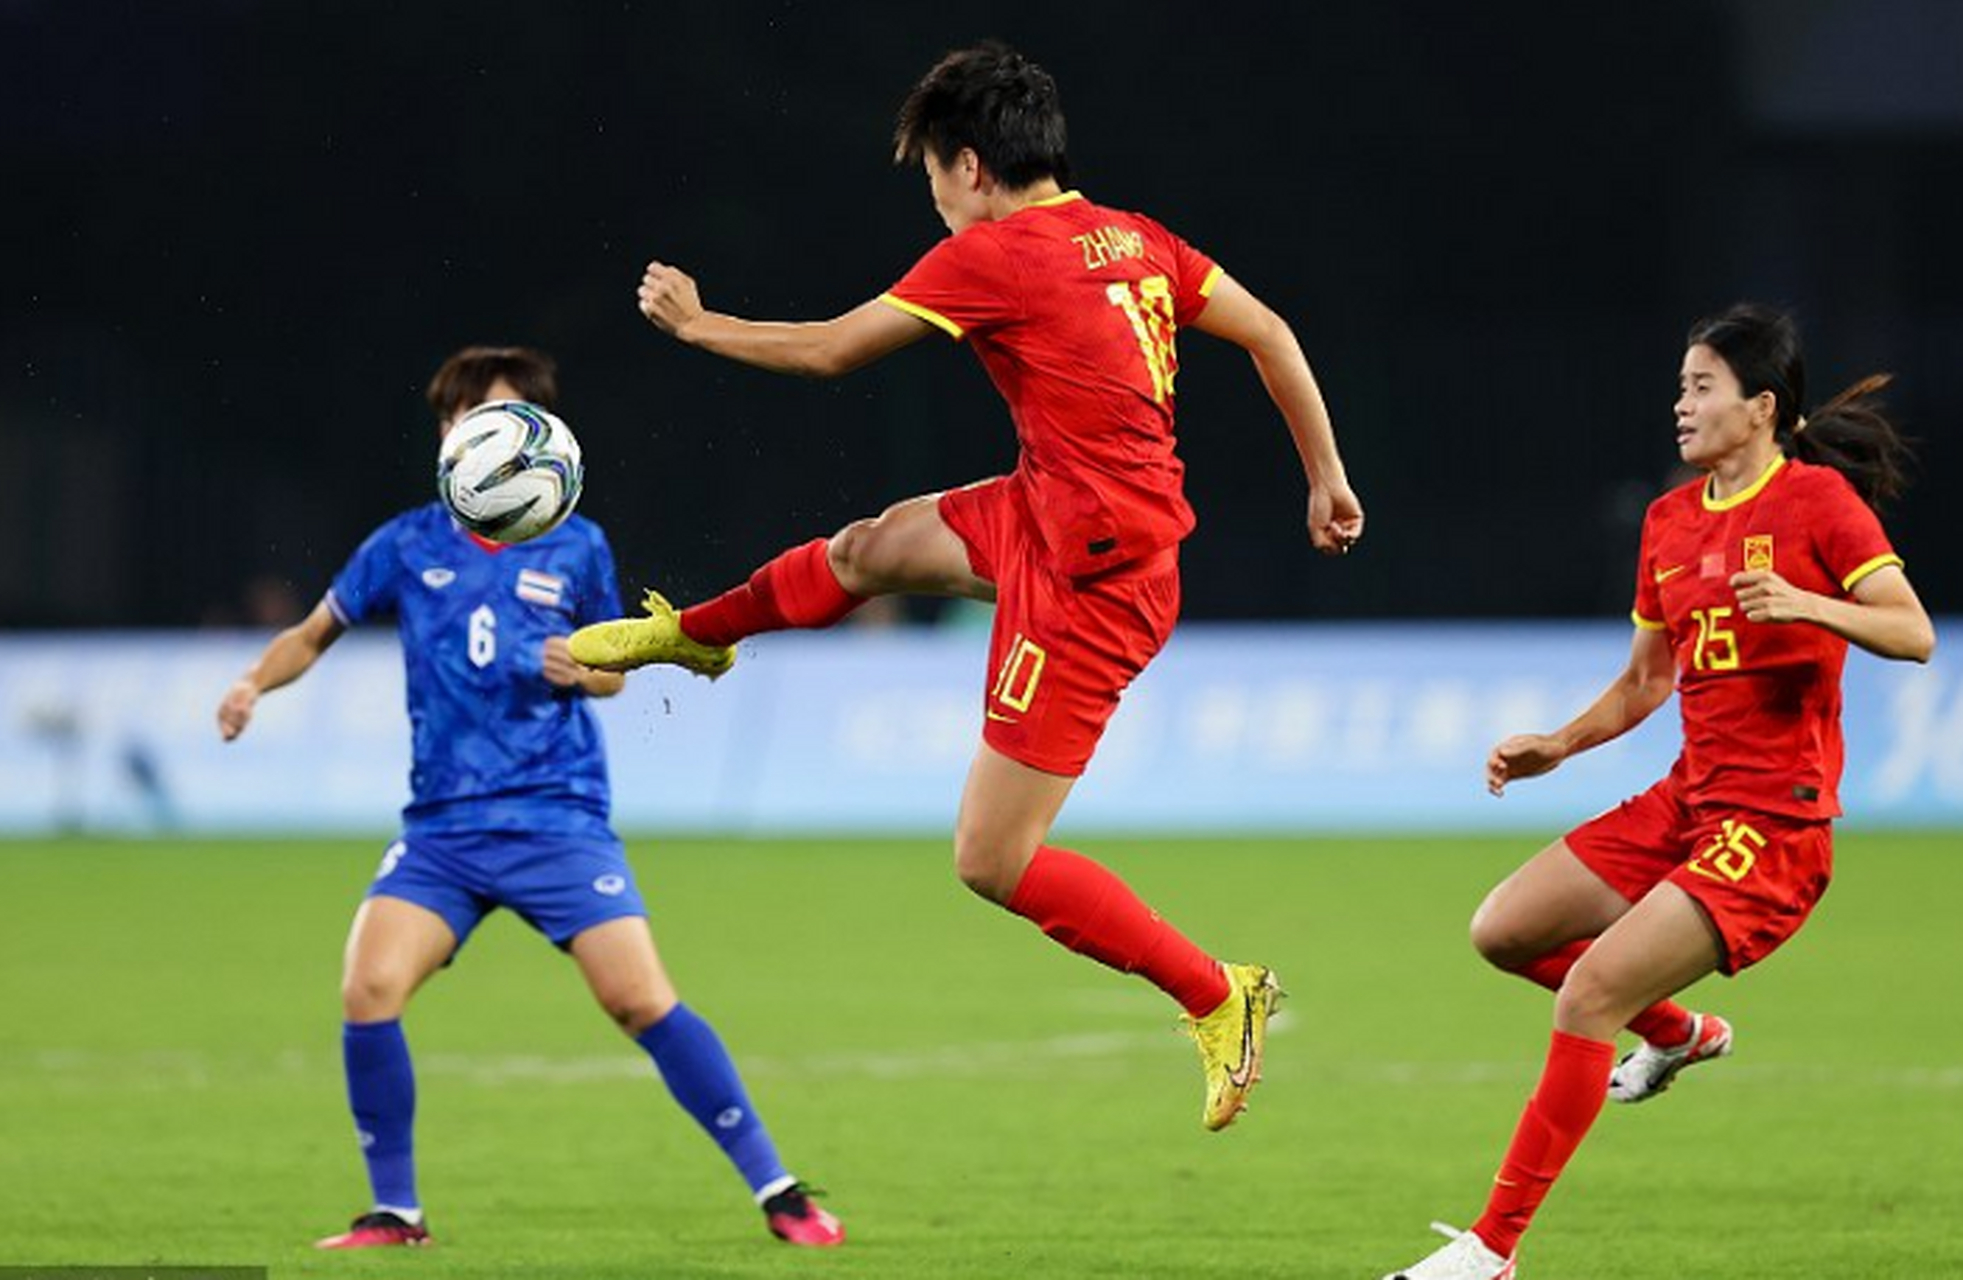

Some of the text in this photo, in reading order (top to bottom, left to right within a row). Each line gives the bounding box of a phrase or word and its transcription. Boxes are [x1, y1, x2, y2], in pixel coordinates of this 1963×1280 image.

[1105, 274, 1178, 403] 10
[468, 603, 496, 669] 6
[992, 632, 1046, 713] 10
[1691, 607, 1739, 670] 15
